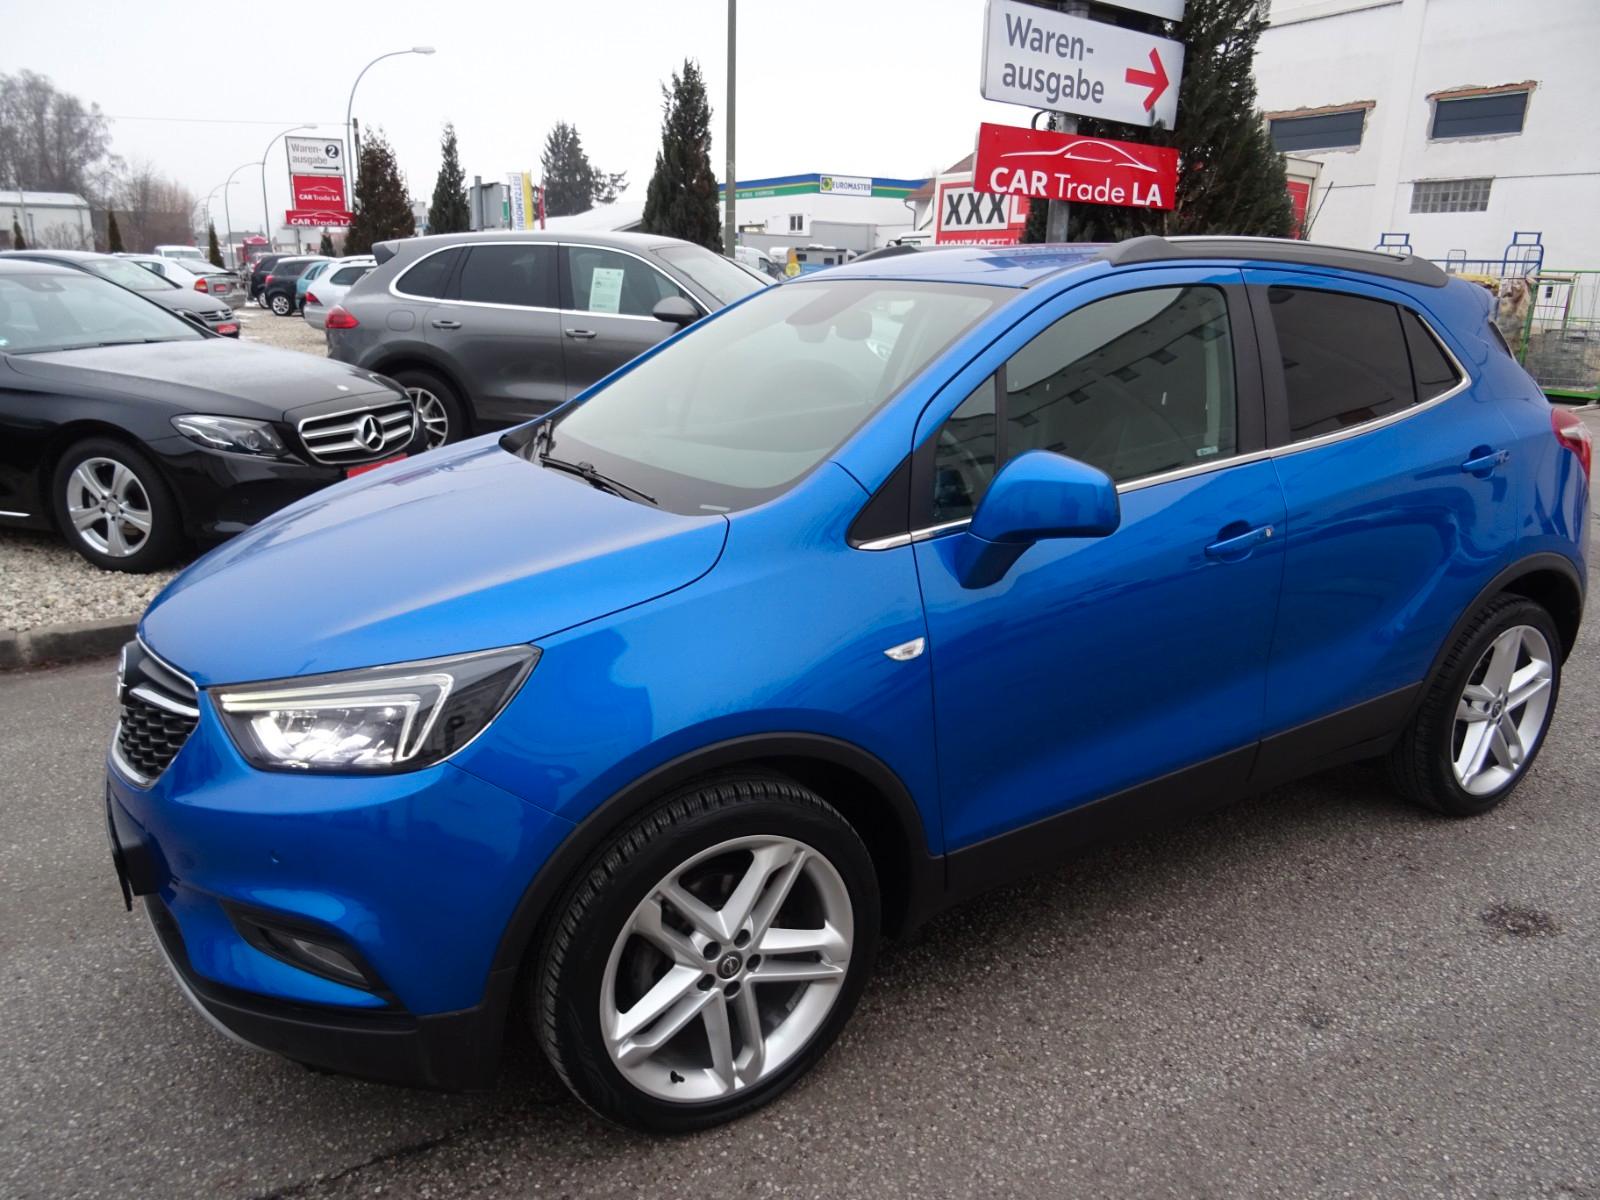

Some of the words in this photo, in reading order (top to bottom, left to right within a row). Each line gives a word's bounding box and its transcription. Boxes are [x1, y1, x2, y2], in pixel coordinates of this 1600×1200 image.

[1005, 13, 1094, 61] Waren-
[1002, 62, 1104, 104] ausgabe
[291, 144, 321, 153] Waren-
[327, 145, 337, 158] 2
[292, 156, 328, 165] ausgabe
[832, 181, 870, 191] EUROMASTER
[989, 167, 1048, 197] CAR
[1054, 172, 1125, 203] Trade
[1132, 182, 1162, 207] LA
[944, 192, 1026, 226] XXXL
[291, 218, 310, 226] CAR
[312, 218, 338, 226] Trade
